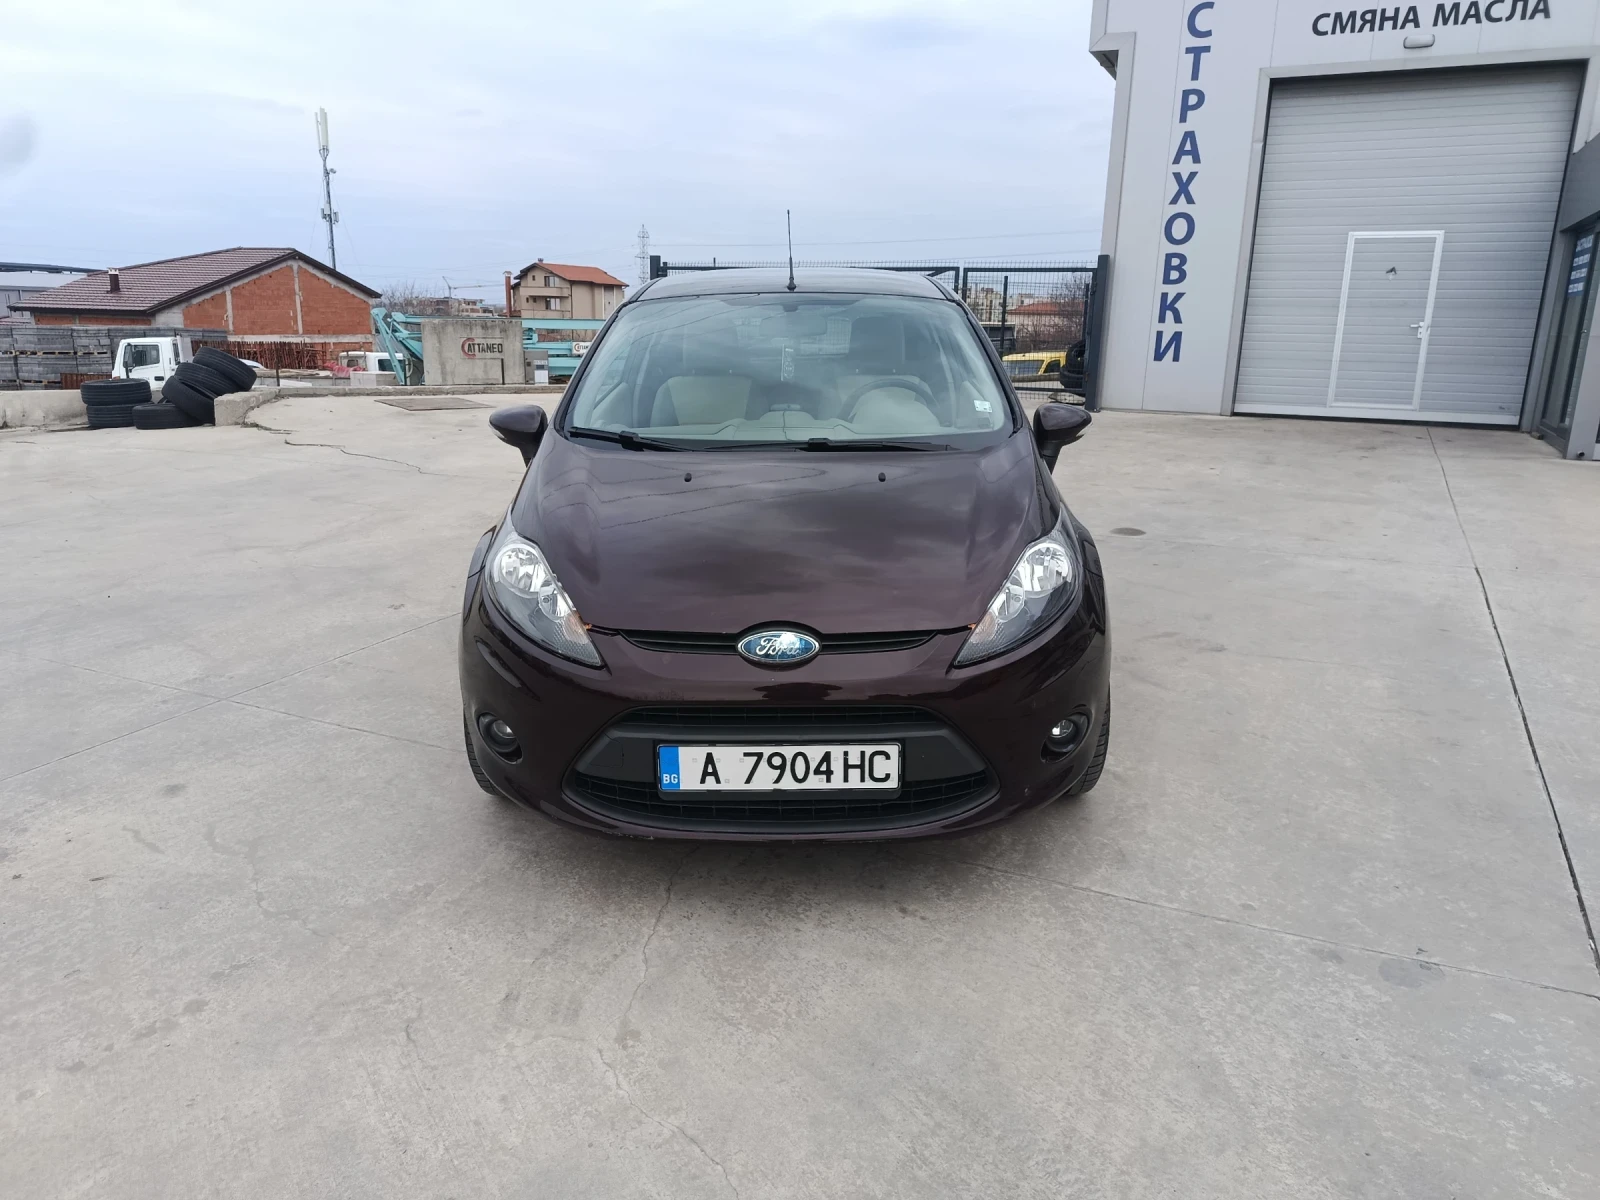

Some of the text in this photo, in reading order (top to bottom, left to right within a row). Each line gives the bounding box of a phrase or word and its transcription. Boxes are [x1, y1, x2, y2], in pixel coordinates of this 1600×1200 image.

[1311, 0, 1551, 36] СМЯНА МАСЛА
[461, 337, 503, 359] CATTANEO
[756, 634, 800, 656] Ford
[663, 773, 679, 784] BG
